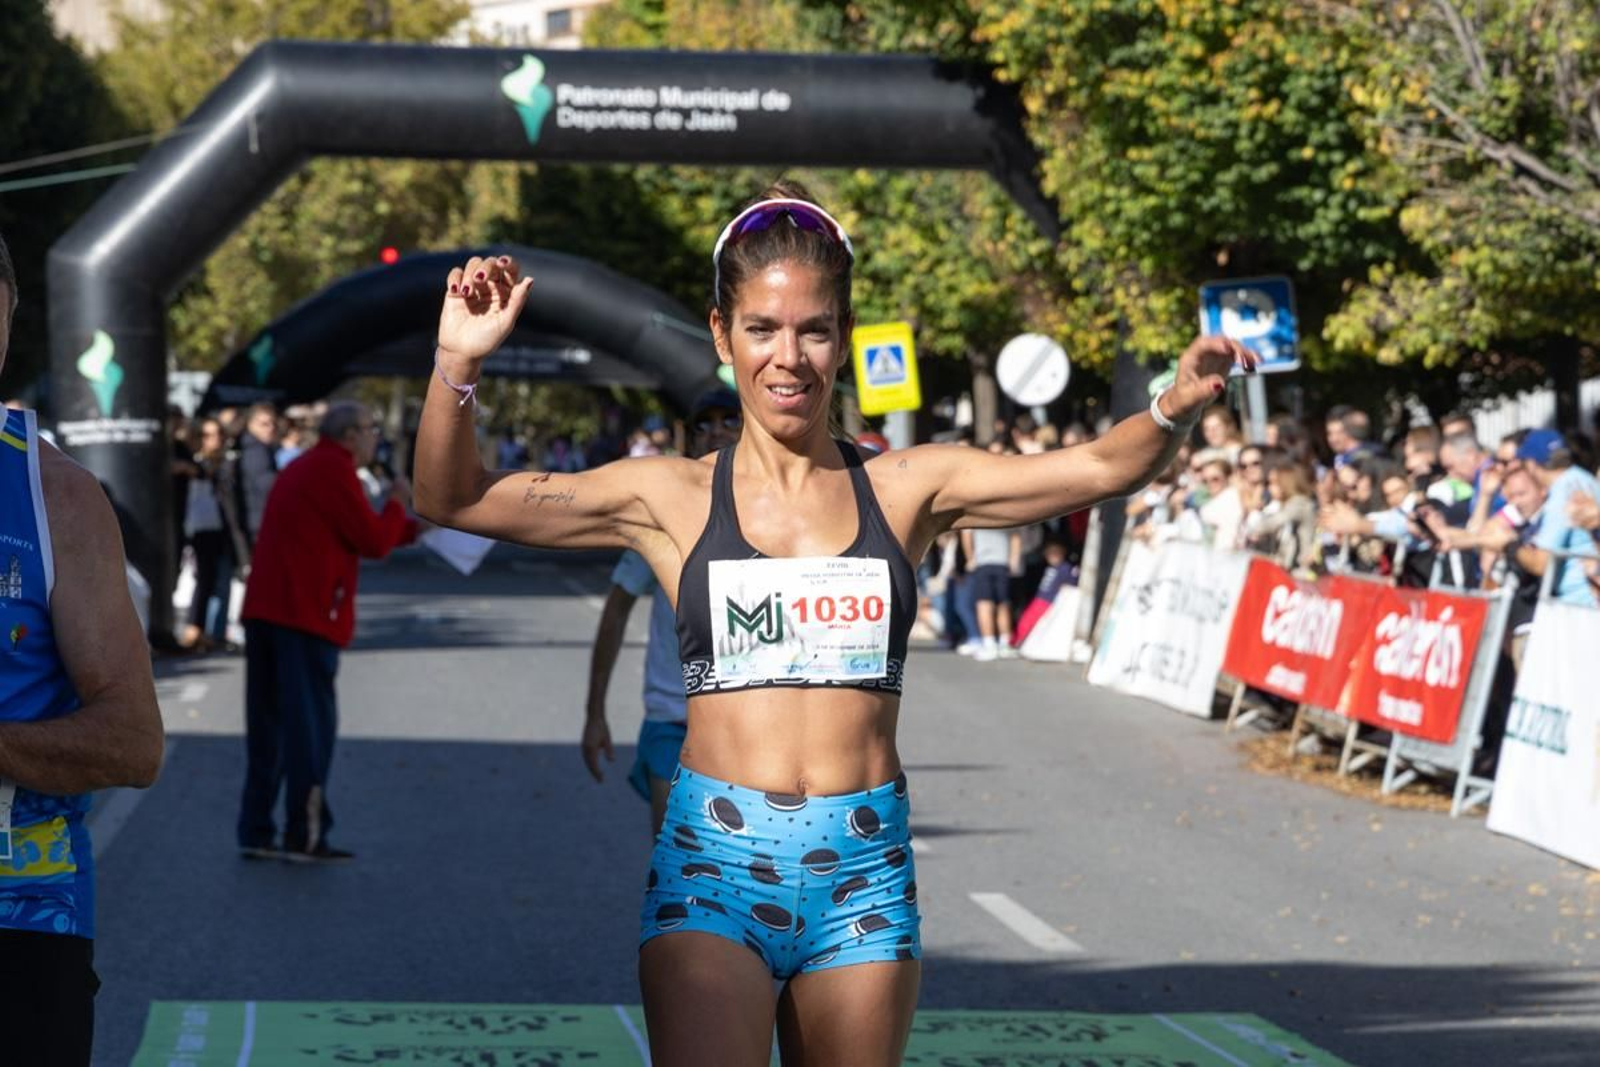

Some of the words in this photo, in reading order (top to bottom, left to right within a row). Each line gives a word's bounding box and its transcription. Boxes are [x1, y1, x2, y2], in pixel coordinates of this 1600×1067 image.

[557, 84, 657, 107] Patronato
[659, 86, 760, 111] Municipal
[761, 89, 791, 111] de
[557, 106, 652, 132] Deportes
[653, 110, 684, 130] de
[685, 109, 738, 132] Jaén
[791, 595, 885, 624] 1030
